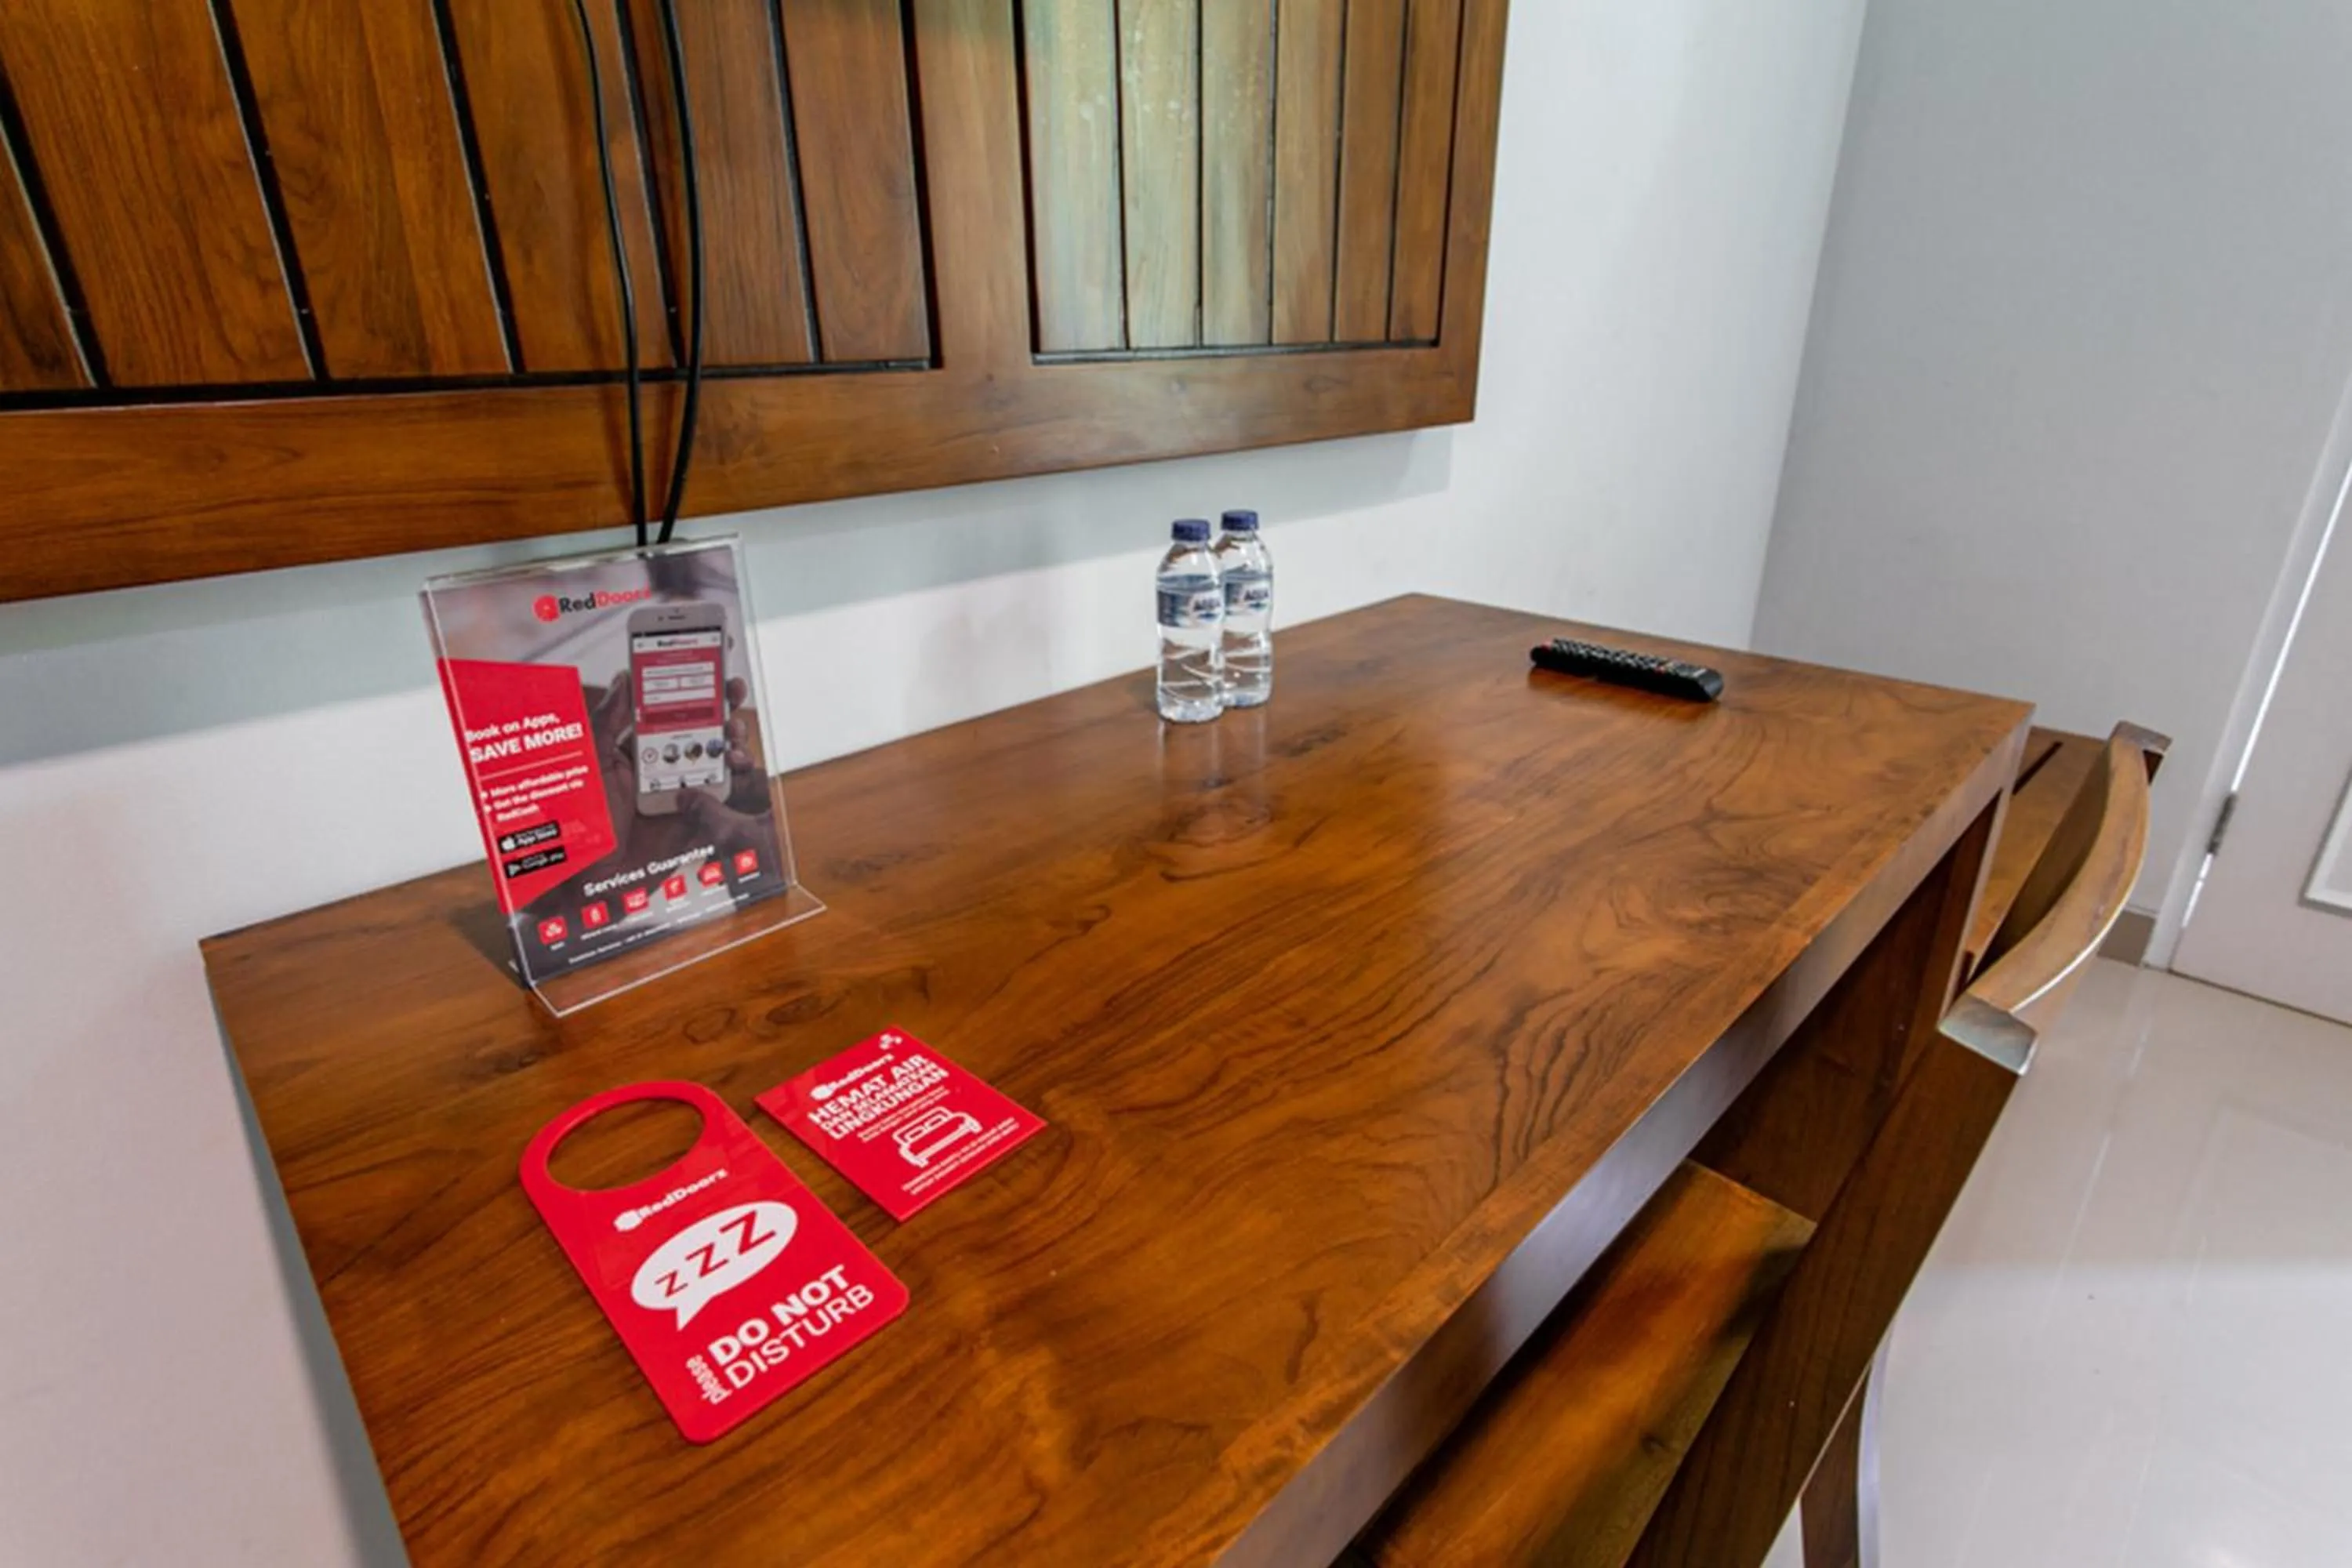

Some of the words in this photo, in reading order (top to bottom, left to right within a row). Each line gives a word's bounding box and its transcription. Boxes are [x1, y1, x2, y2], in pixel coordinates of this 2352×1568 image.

[464, 724, 499, 742] Book
[503, 720, 521, 734] on
[470, 738, 521, 763] SAVE
[524, 722, 583, 750] MORE!
[583, 866, 646, 897] Services
[647, 844, 715, 875] Guarantee
[806, 1073, 888, 1123] HEMAT
[889, 1052, 929, 1079] AIR
[708, 1318, 770, 1366] DO
[771, 1264, 849, 1326] NOT
[724, 1284, 874, 1389] DISTURB
